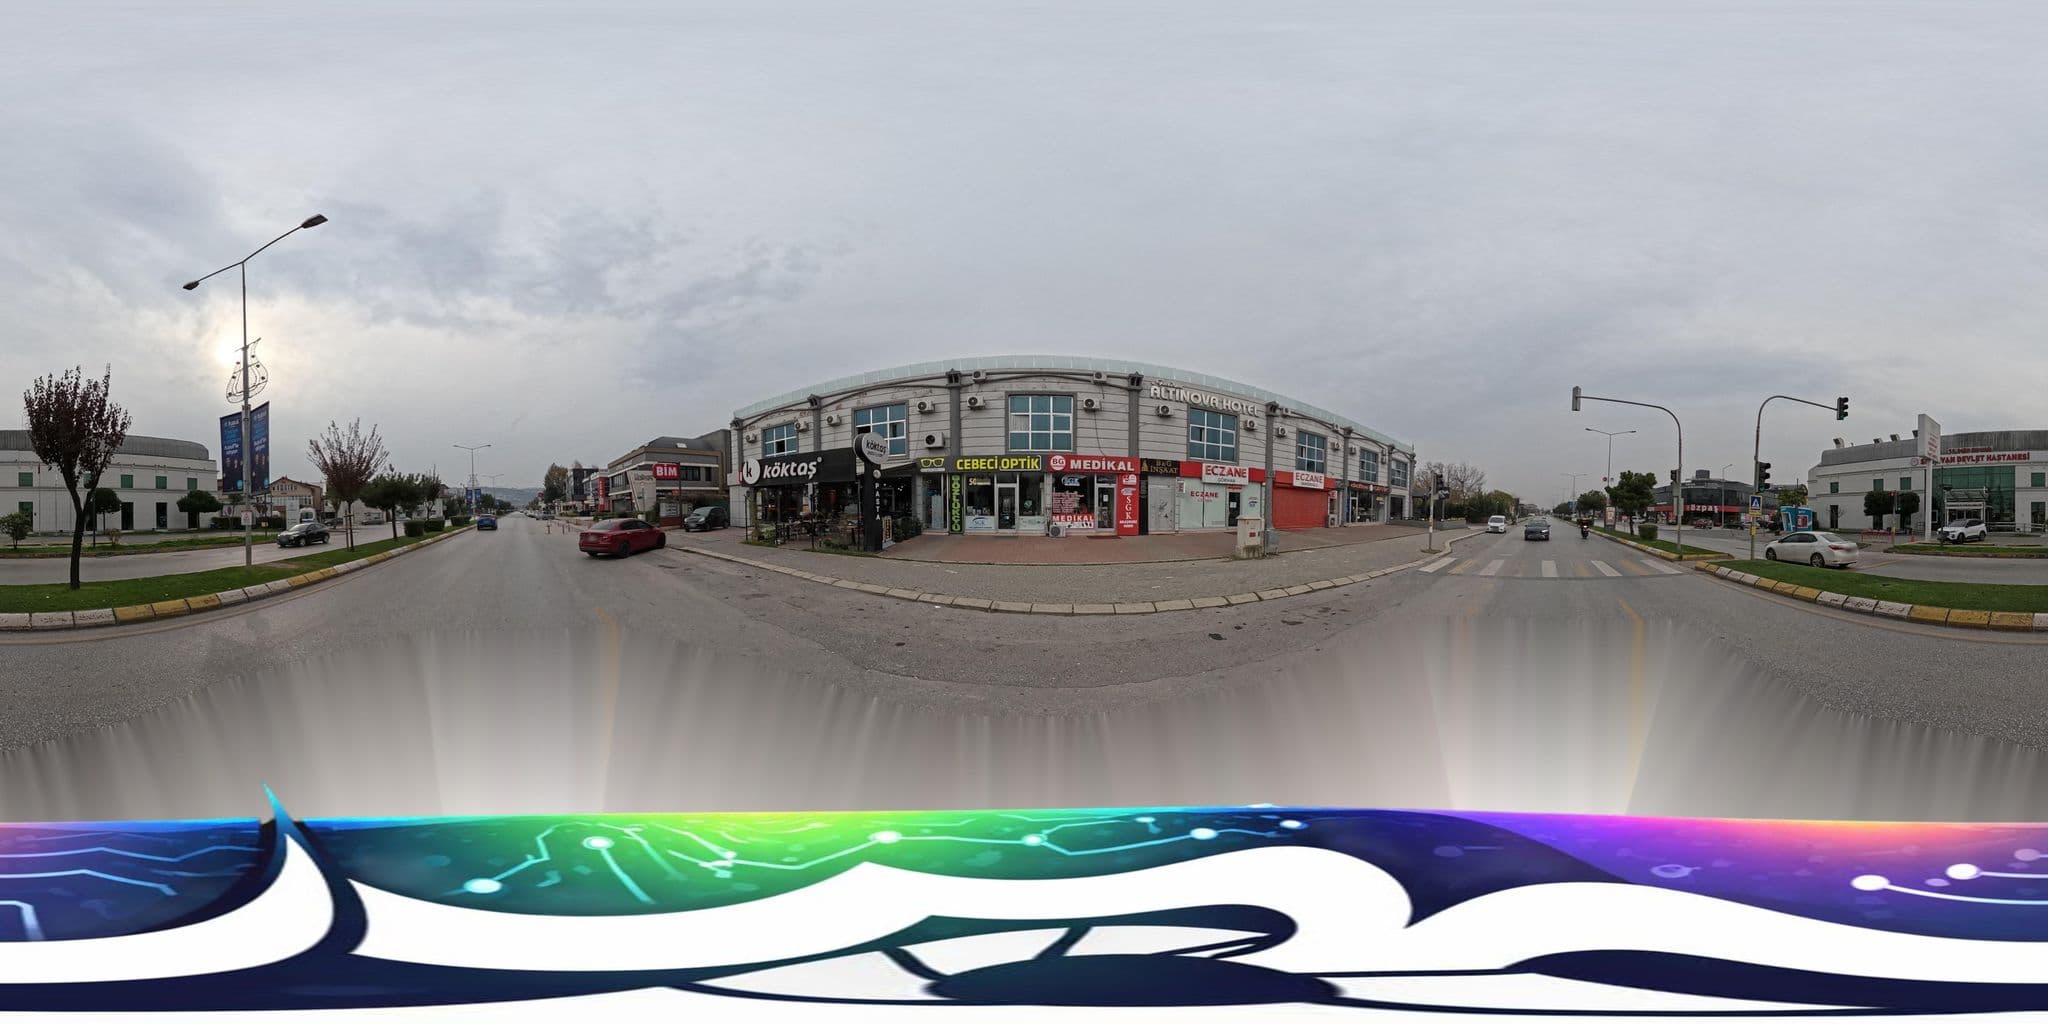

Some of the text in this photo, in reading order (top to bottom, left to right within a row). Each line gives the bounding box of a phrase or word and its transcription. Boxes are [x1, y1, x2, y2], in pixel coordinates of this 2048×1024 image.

[1150, 385, 1260, 418] ALTINOVA HOTEL
[956, 455, 1039, 470] CEBECİ OPTİK
[1957, 455, 1985, 463] DEVLET
[1986, 452, 2030, 462] HASTANESİ
[656, 463, 678, 476] BİM
[763, 461, 817, 479] köktaş
[1070, 458, 1135, 471] MEDİKAL
[1204, 464, 1248, 479] ECZANE
[1295, 472, 1323, 484] ECZANE
[1190, 490, 1219, 498] ECZANE
